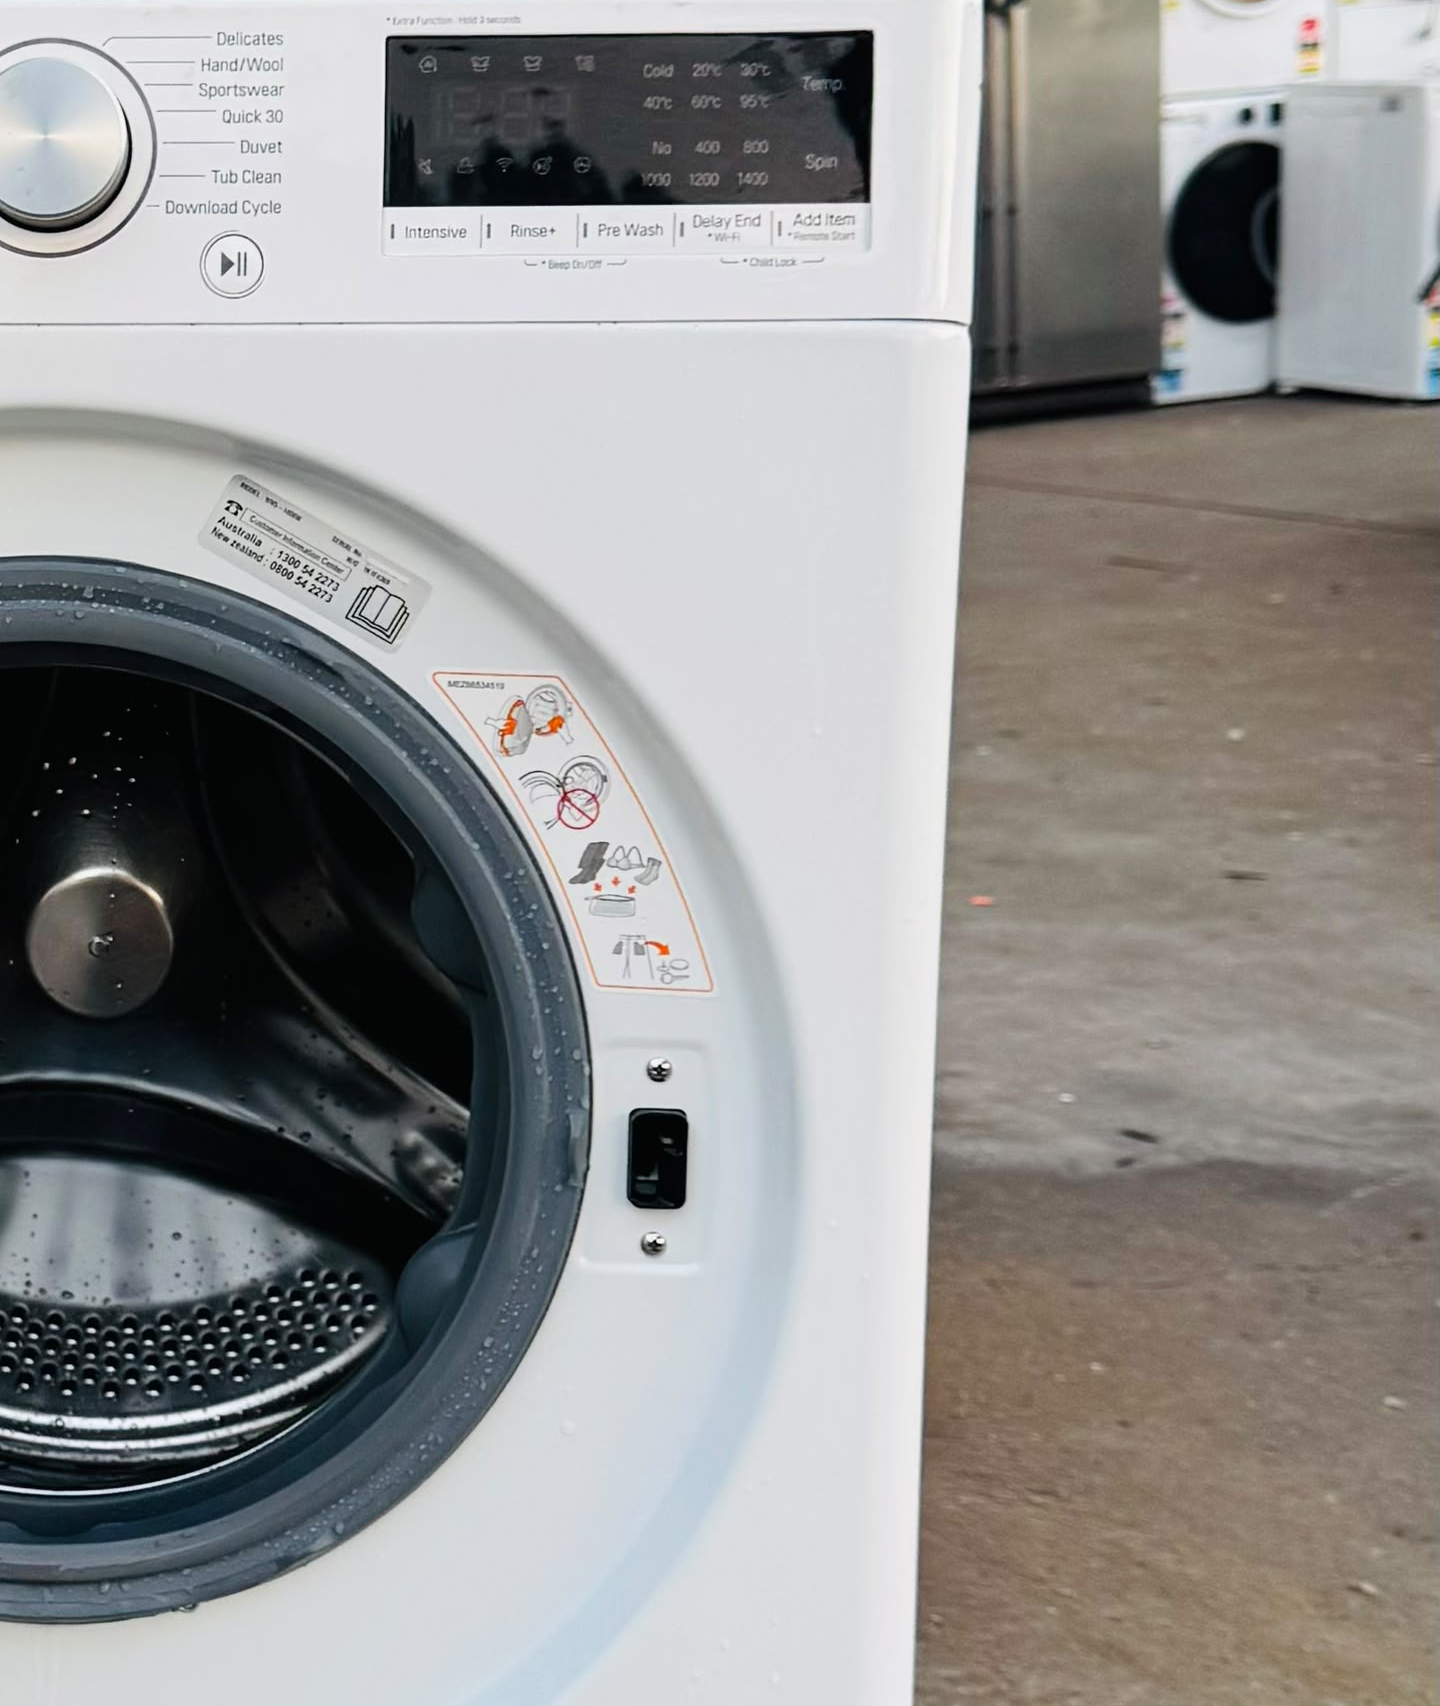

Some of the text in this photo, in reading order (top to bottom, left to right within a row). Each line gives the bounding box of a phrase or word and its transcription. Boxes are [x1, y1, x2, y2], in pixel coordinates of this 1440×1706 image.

[216, 31, 284, 46] Delicates
[201, 57, 284, 72] Hand/Wool
[642, 63, 675, 78] Cold
[198, 82, 285, 100] Sportswear
[222, 109, 284, 124] Quick 30
[240, 139, 282, 154] Duvet
[652, 140, 769, 155] No 400 800
[804, 153, 838, 172] Spin
[211, 169, 281, 184] Tub Clean
[689, 173, 720, 186] 1200
[737, 172, 769, 186] 1400
[165, 200, 282, 217] Download Cycle
[692, 213, 762, 230] Delay End
[792, 212, 855, 227] Add Item
[405, 225, 467, 239] Intensive
[510, 223, 556, 238] Rinse+
[598, 222, 664, 237] Pre Wash
[217, 515, 263, 547] Australia
[277, 550, 301, 569] 1300
[301, 564, 315, 577] 54
[314, 572, 340, 592] 2273
[211, 526, 230, 543] New
[269, 561, 294, 580] 0800
[294, 576, 309, 589] 54
[308, 583, 334, 603] 2273
